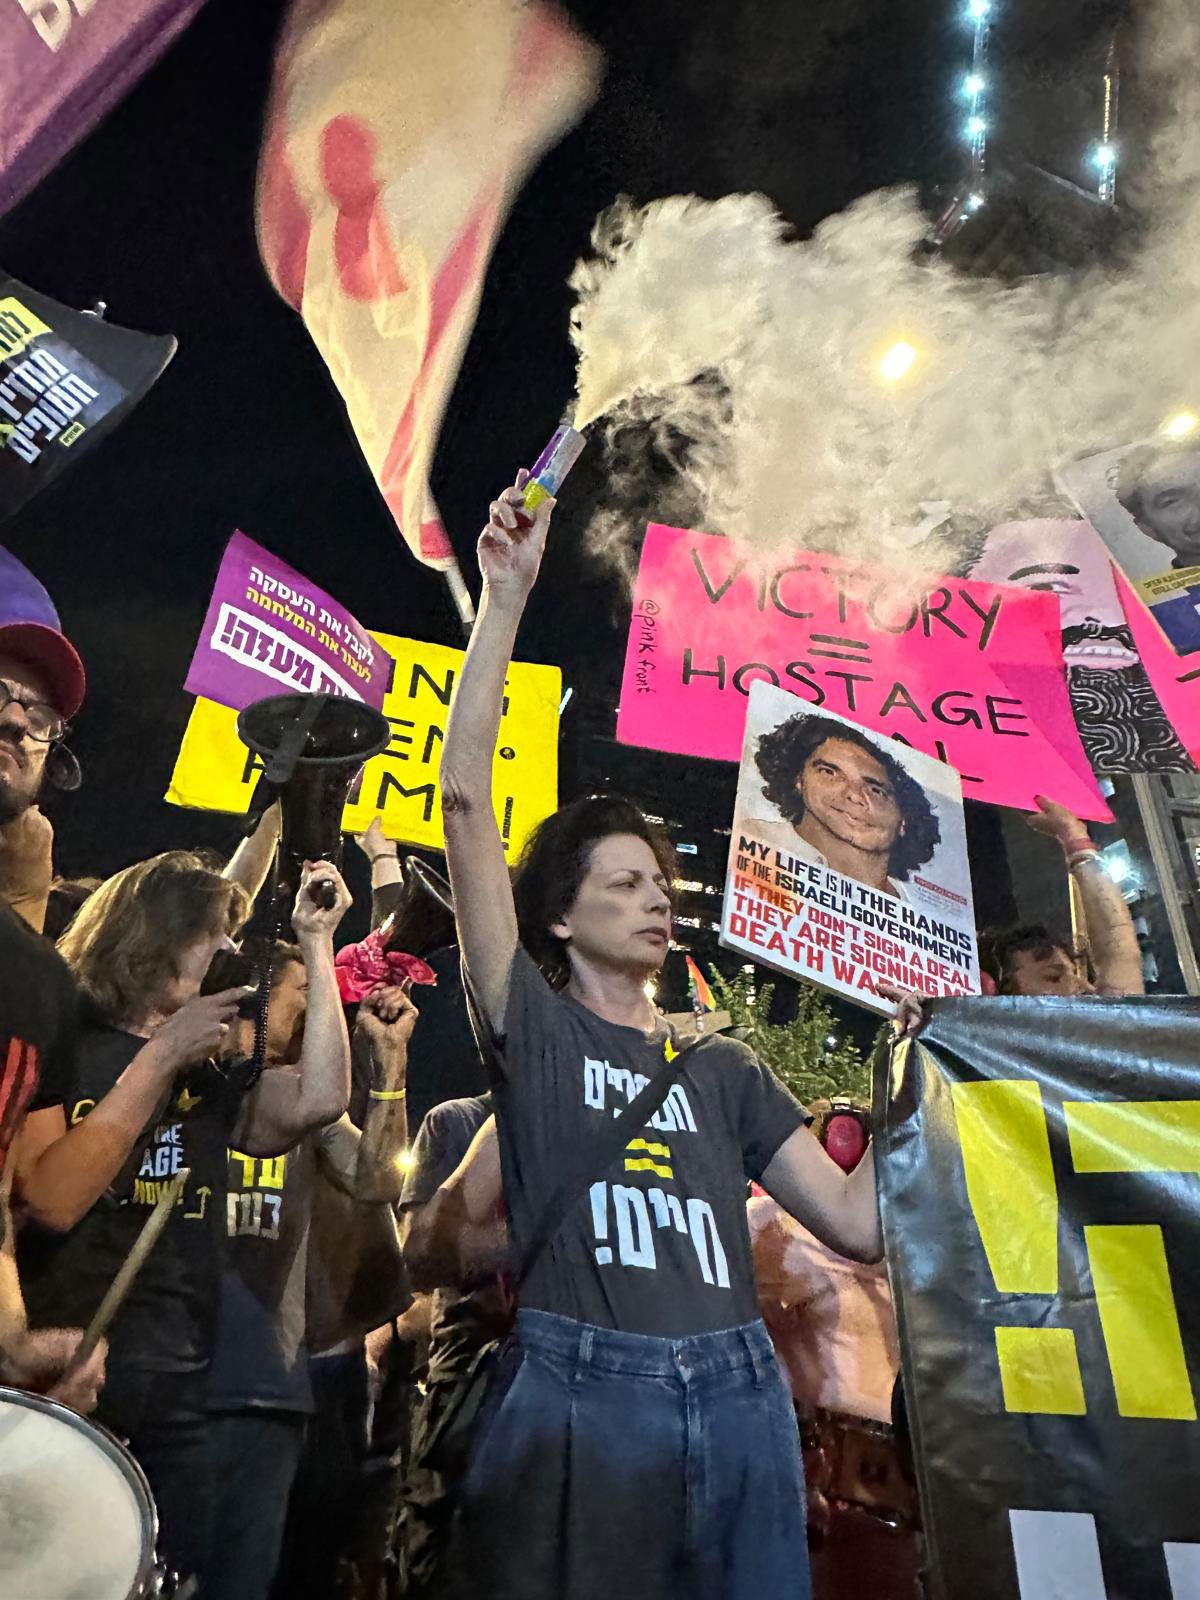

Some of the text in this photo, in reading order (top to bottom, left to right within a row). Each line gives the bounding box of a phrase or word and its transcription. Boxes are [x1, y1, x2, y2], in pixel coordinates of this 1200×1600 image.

[7, 372, 100, 464] חטופים
[246, 586, 317, 638] המלחמה
[249, 565, 375, 666] לקבל את העסקה
[317, 628, 341, 655] את
[689, 547, 1004, 652] VICTORY
[340, 647, 373, 684] לעצור
[682, 647, 1031, 738] HOSTAGE
[729, 911, 824, 973] DEATH
[734, 874, 976, 993] IF THEY DON'T SIGN A DEAL
[737, 854, 972, 970] OF THE ISRAELI GOVERNMENT
[738, 835, 771, 861] MY
[775, 851, 821, 885] LIFE
[826, 873, 838, 892] IS
[840, 879, 852, 899] IN
[857, 886, 897, 919] THE
[902, 906, 972, 951] HANDS
[733, 891, 793, 932] THEY
[797, 921, 845, 957] ARE
[850, 942, 939, 997] SIGNING
[589, 1180, 731, 1289] חיים!
